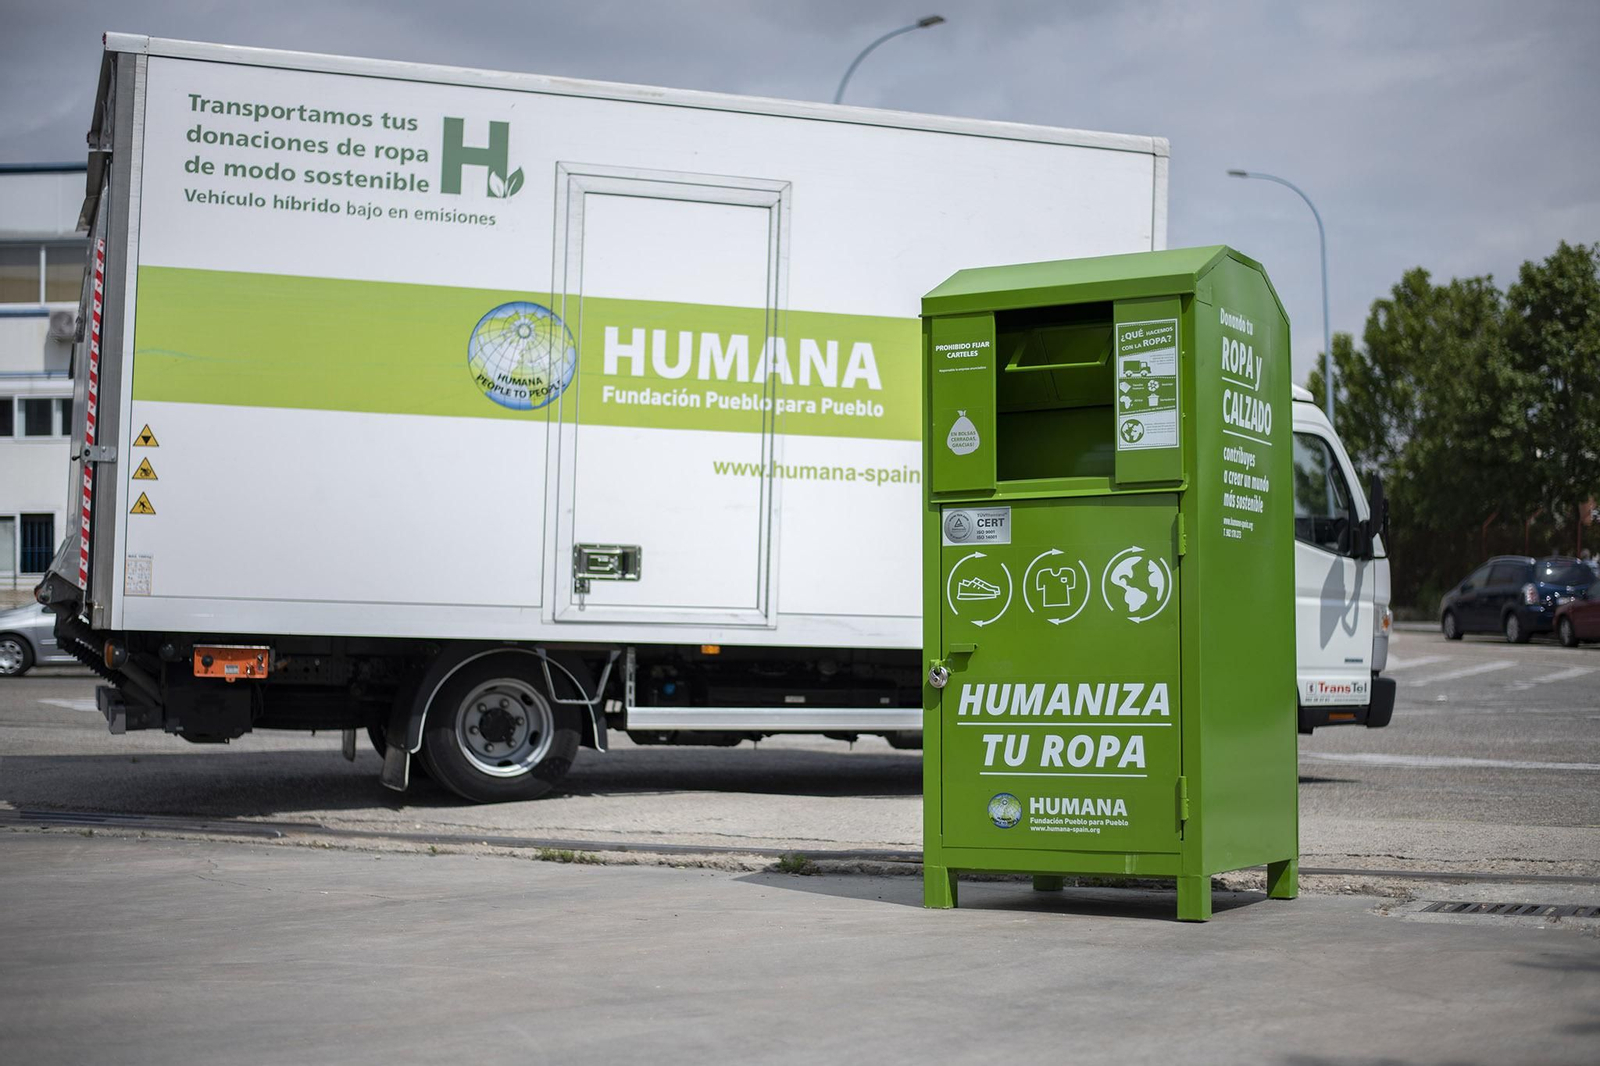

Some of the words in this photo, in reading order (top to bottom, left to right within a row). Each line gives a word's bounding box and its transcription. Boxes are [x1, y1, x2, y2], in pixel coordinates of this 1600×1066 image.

[188, 93, 373, 128] Transportamos
[381, 111, 418, 132] tus
[186, 124, 329, 154] donaciones
[336, 138, 366, 157] de
[374, 144, 429, 166] ropa
[184, 156, 215, 175] de
[224, 158, 296, 182] modo
[304, 166, 430, 193] sostenible
[184, 188, 266, 208] Vehículo
[273, 194, 341, 214] híbrido
[346, 200, 383, 221] bajo
[388, 207, 408, 220] en
[414, 207, 497, 226] emisiones
[935, 342, 971, 351] PROHIBIDO
[1120, 328, 1144, 343] ¿QUÉ
[1145, 326, 1174, 336] HACEMOS
[1142, 334, 1172, 347] ROPA?
[603, 326, 883, 390] HUMANA
[946, 350, 979, 359] CARTELES
[1221, 336, 1253, 380] ROPA
[1255, 355, 1263, 392] y
[476, 373, 512, 397] PEOPLE
[514, 389, 527, 398] TO
[497, 373, 543, 386] HUMANA
[602, 385, 701, 408] Fundación
[705, 391, 772, 411] Pueblo
[775, 397, 816, 416] para
[821, 397, 884, 417] Pueblo
[1223, 388, 1272, 436] CALZADO
[1223, 446, 1256, 471] contribuyes
[1228, 470, 1244, 487] crear
[1243, 474, 1251, 489] un
[1251, 475, 1270, 493] mundo
[1236, 494, 1264, 514] sostenible
[976, 518, 1005, 528] CERT
[957, 682, 1171, 717] HUMANIZA
[982, 734, 1030, 767] TU
[1040, 734, 1146, 769] ROPA
[1029, 797, 1128, 817] HUMANA
[1029, 816, 1064, 825] Fundación
[1064, 817, 1088, 826] Pueblo
[1088, 819, 1104, 827] para
[1105, 818, 1129, 827] Pueblo
[1030, 825, 1101, 834] www.humana-spain.org
